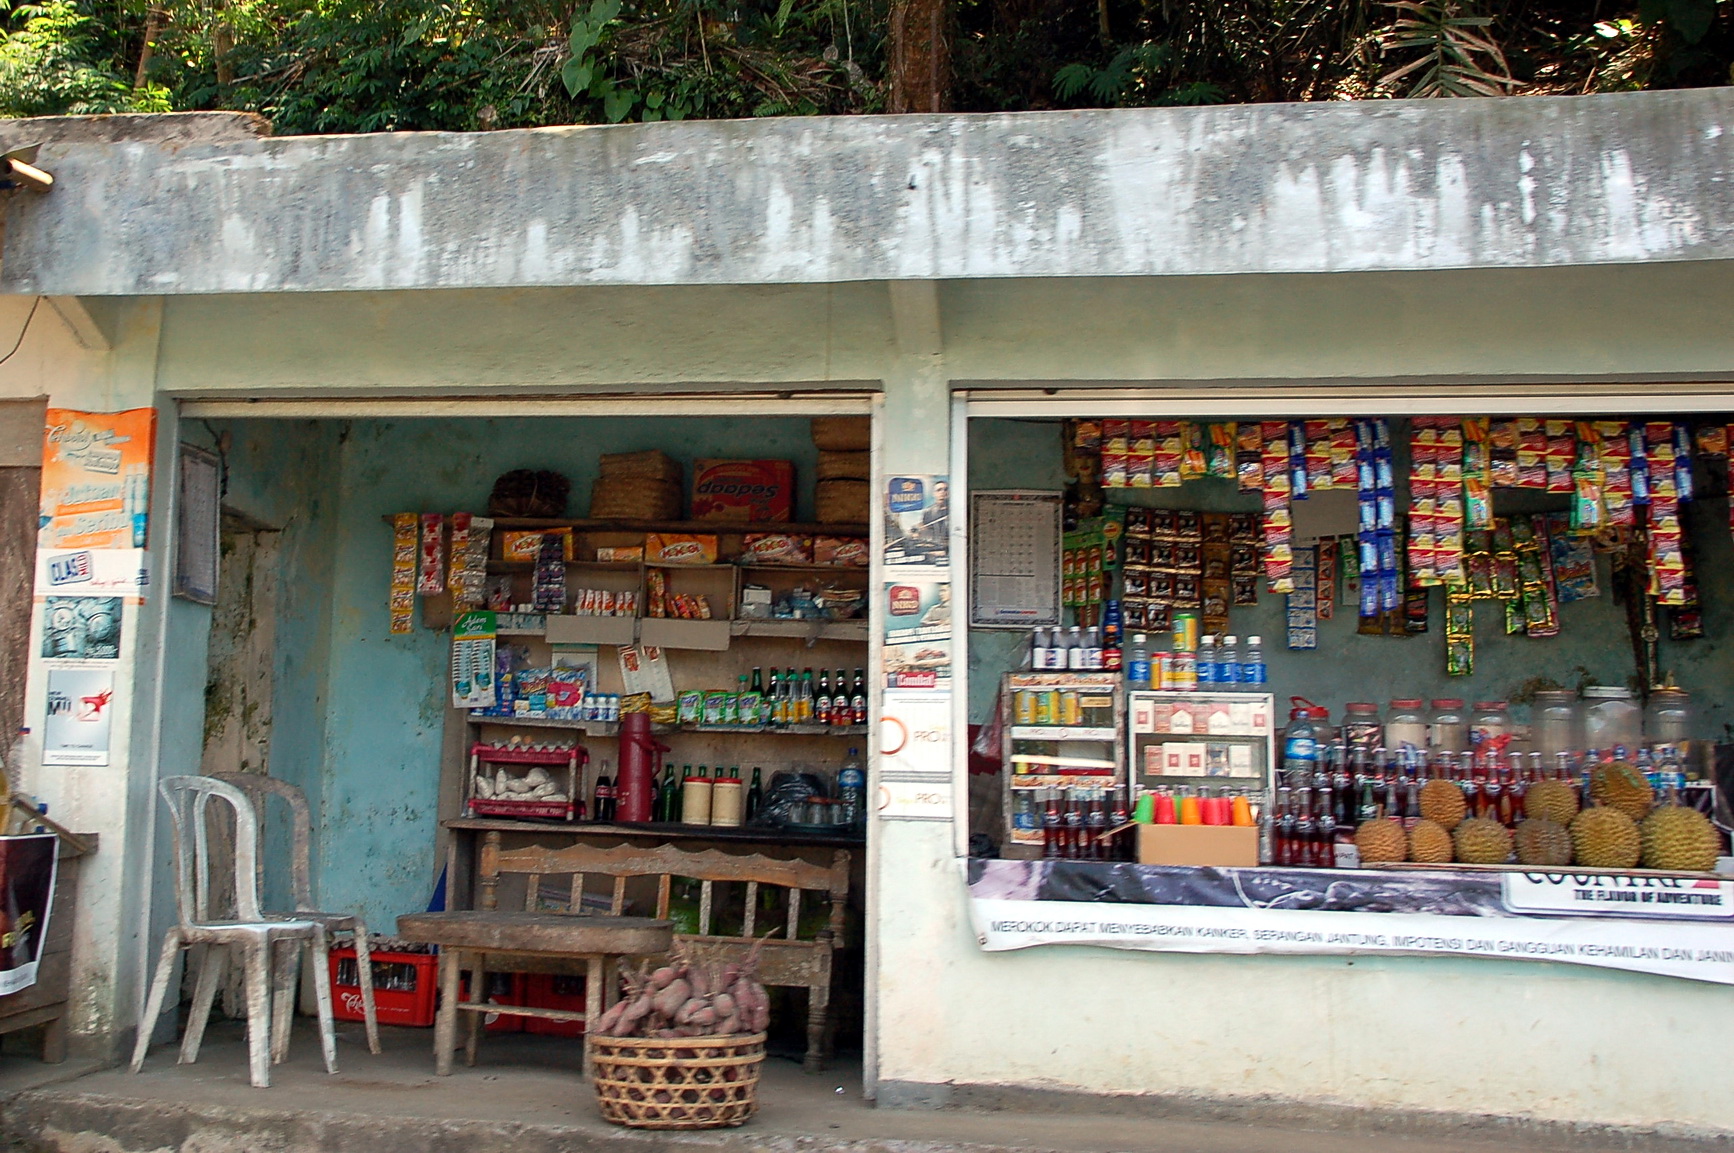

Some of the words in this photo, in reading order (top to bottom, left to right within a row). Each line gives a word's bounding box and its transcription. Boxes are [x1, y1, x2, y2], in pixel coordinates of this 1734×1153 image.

[1574, 889, 1593, 900] THE
[1597, 890, 1637, 902] FLAVOR
[1641, 891, 1653, 902] OF
[1657, 892, 1722, 905] ADVENTURE
[991, 921, 1054, 933] MEROKOK
[1055, 922, 1097, 934] DAPAT
[1099, 923, 1193, 936] MENYEBABKAN
[1197, 927, 1249, 940] KANKER,
[1254, 929, 1323, 942] SERANGAN
[1327, 933, 1389, 947] JANTUNG,
[1392, 936, 1462, 949] IMPOTENSI
[1466, 939, 1495, 951] DAN
[1497, 940, 1575, 954] GANGGUAN
[1578, 944, 1659, 959] KEHAMILAN
[1661, 947, 1693, 960] DAN
